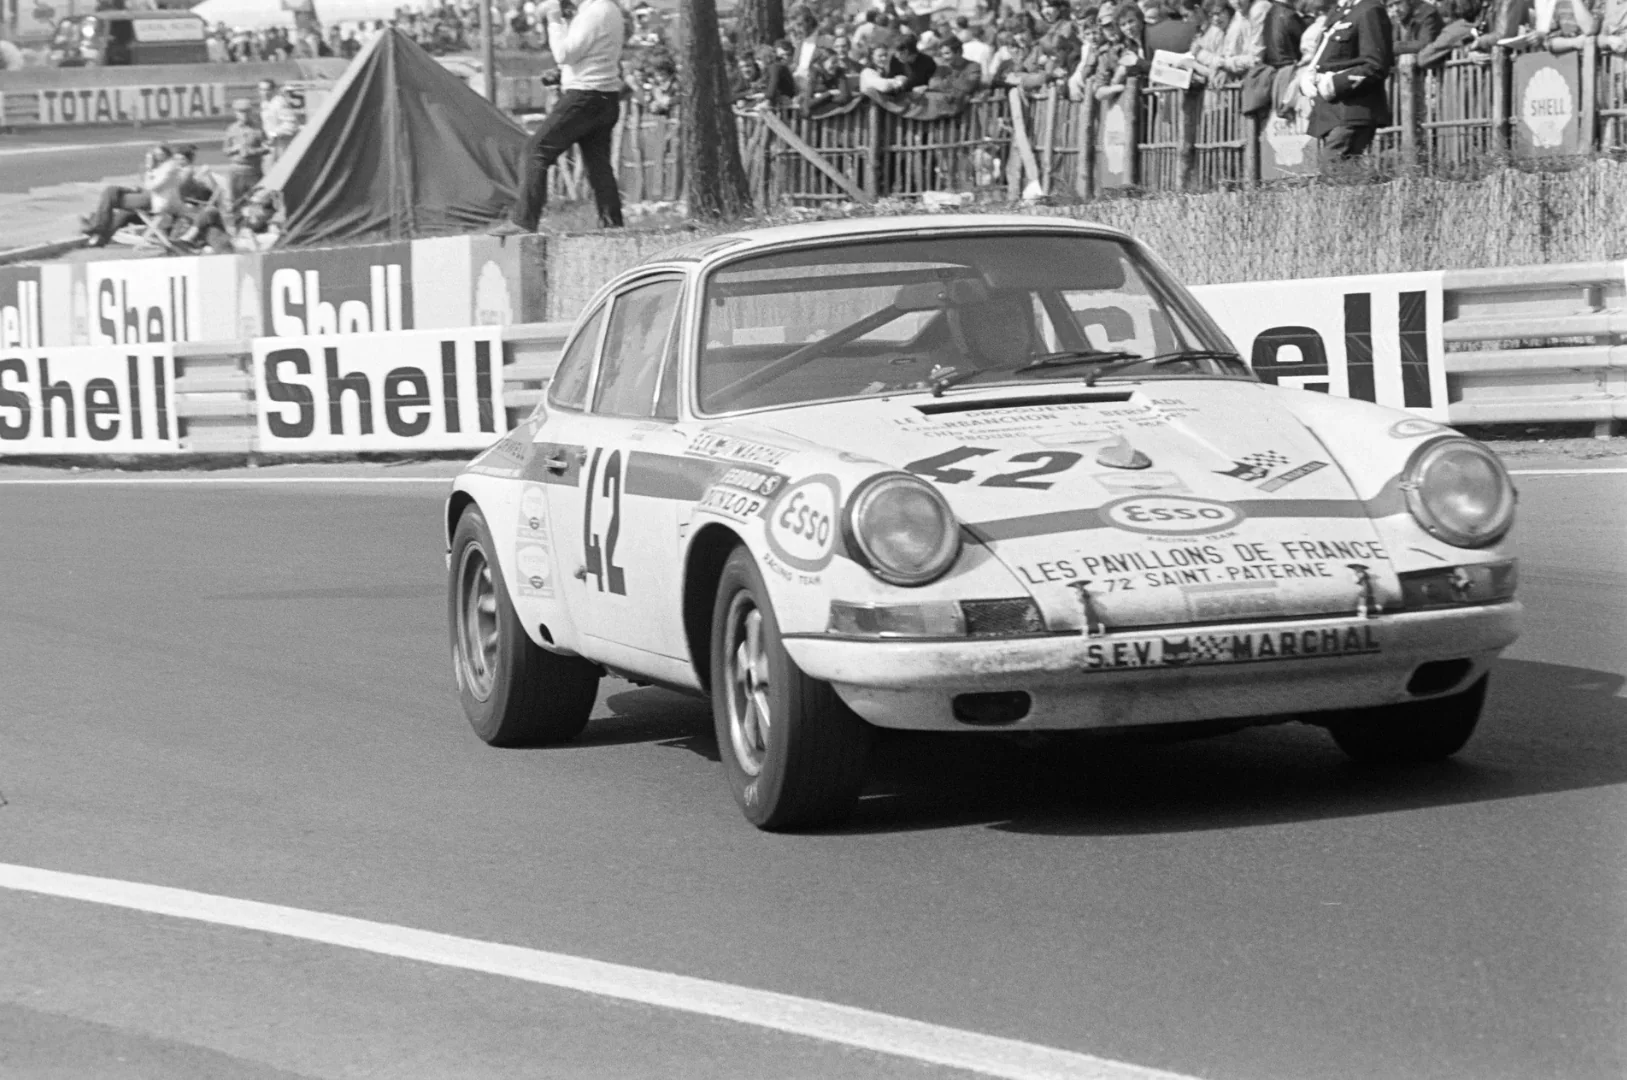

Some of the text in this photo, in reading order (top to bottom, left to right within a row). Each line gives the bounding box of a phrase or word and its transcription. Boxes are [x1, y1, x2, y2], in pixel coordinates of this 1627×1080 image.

[43, 85, 221, 122] TOTAL TOTAL
[1531, 98, 1566, 117] SHELL
[0, 356, 170, 441] Shell
[264, 340, 498, 438] Shell
[903, 445, 1084, 490] 42
[582, 446, 628, 597] 42
[1205, 531, 1239, 541] TEAM
[1018, 540, 1391, 587] LES PAVILLONS DE FRANCE
[1104, 578, 1137, 594] 72
[1231, 625, 1382, 657] MARCHAL
